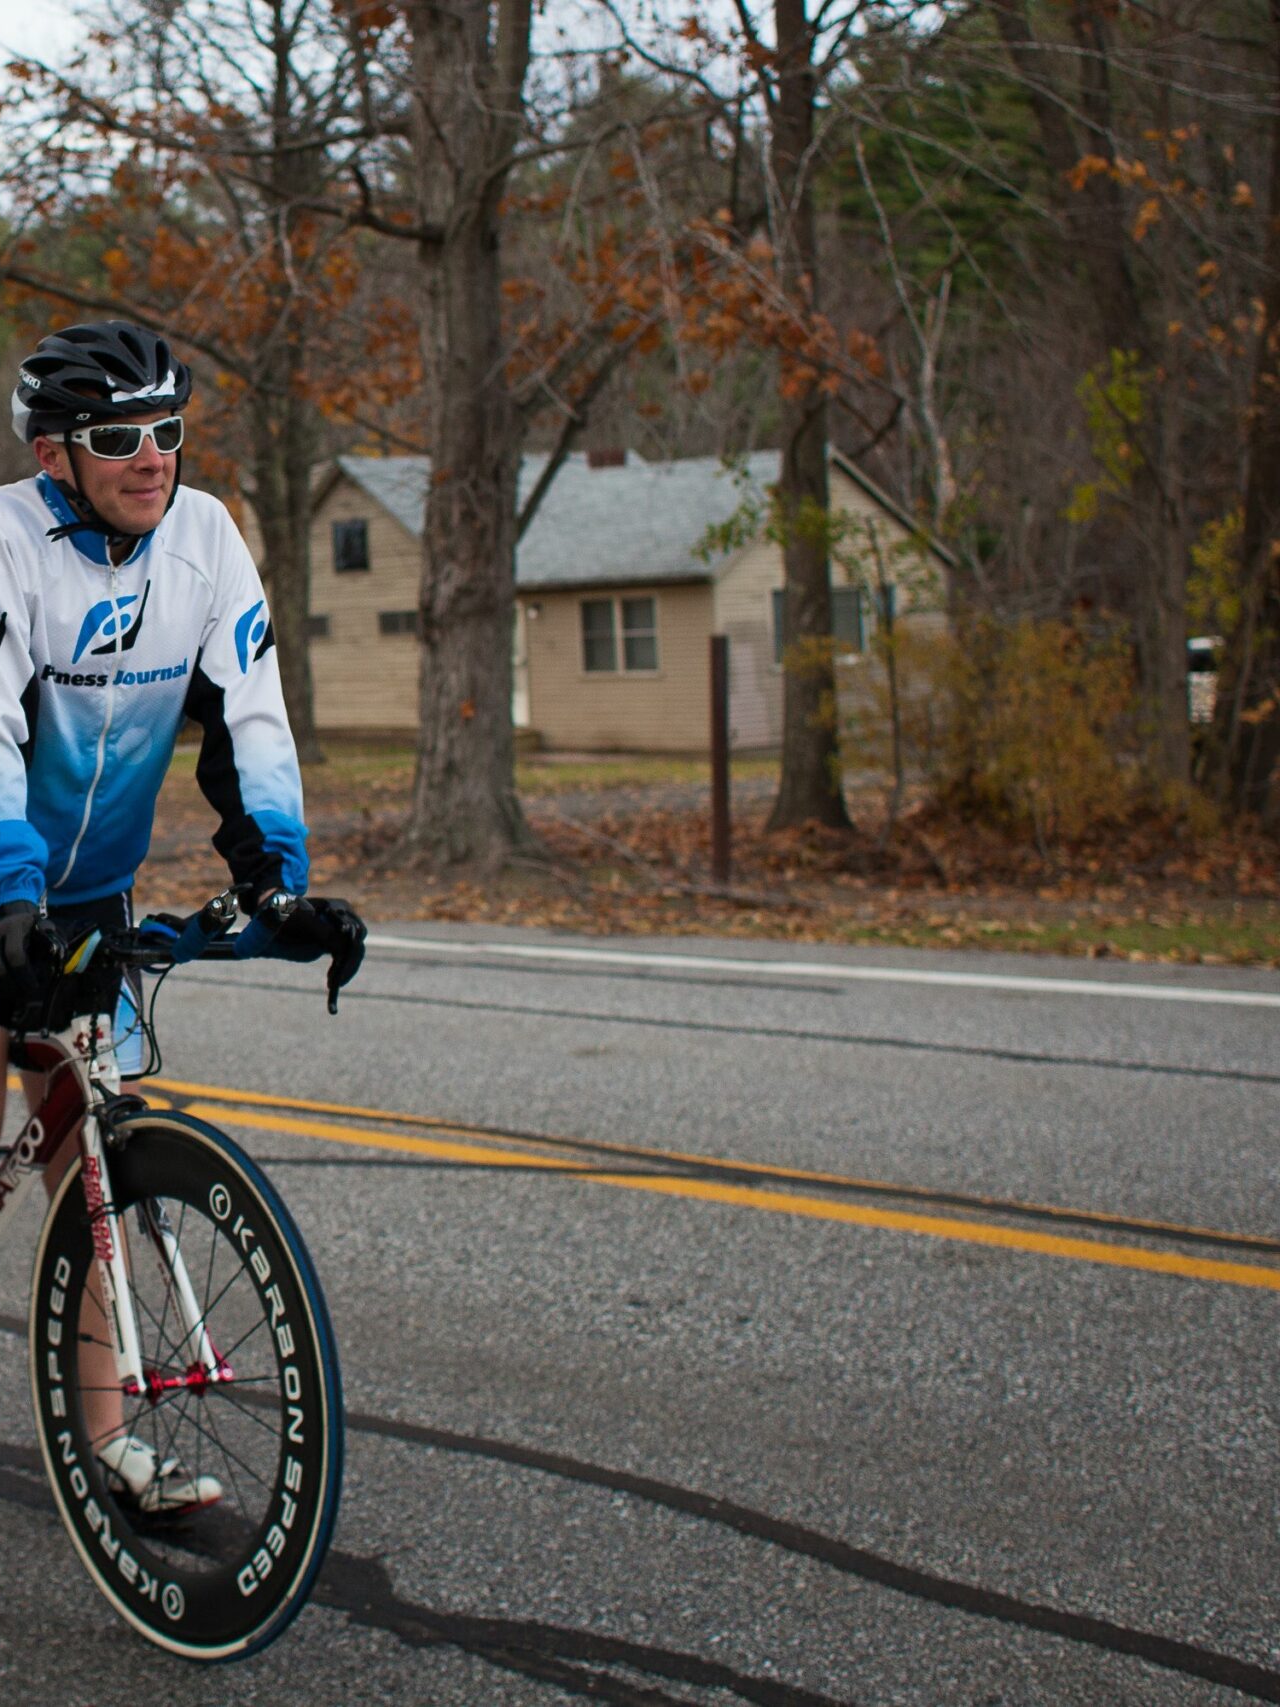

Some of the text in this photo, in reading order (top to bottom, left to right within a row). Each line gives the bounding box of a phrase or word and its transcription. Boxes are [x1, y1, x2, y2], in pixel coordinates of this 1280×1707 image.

[112, 657, 188, 686] Journal
[6, 1116, 45, 1187] ROO
[47, 1256, 72, 1418] SPEED
[237, 1455, 303, 1597] SPEED
